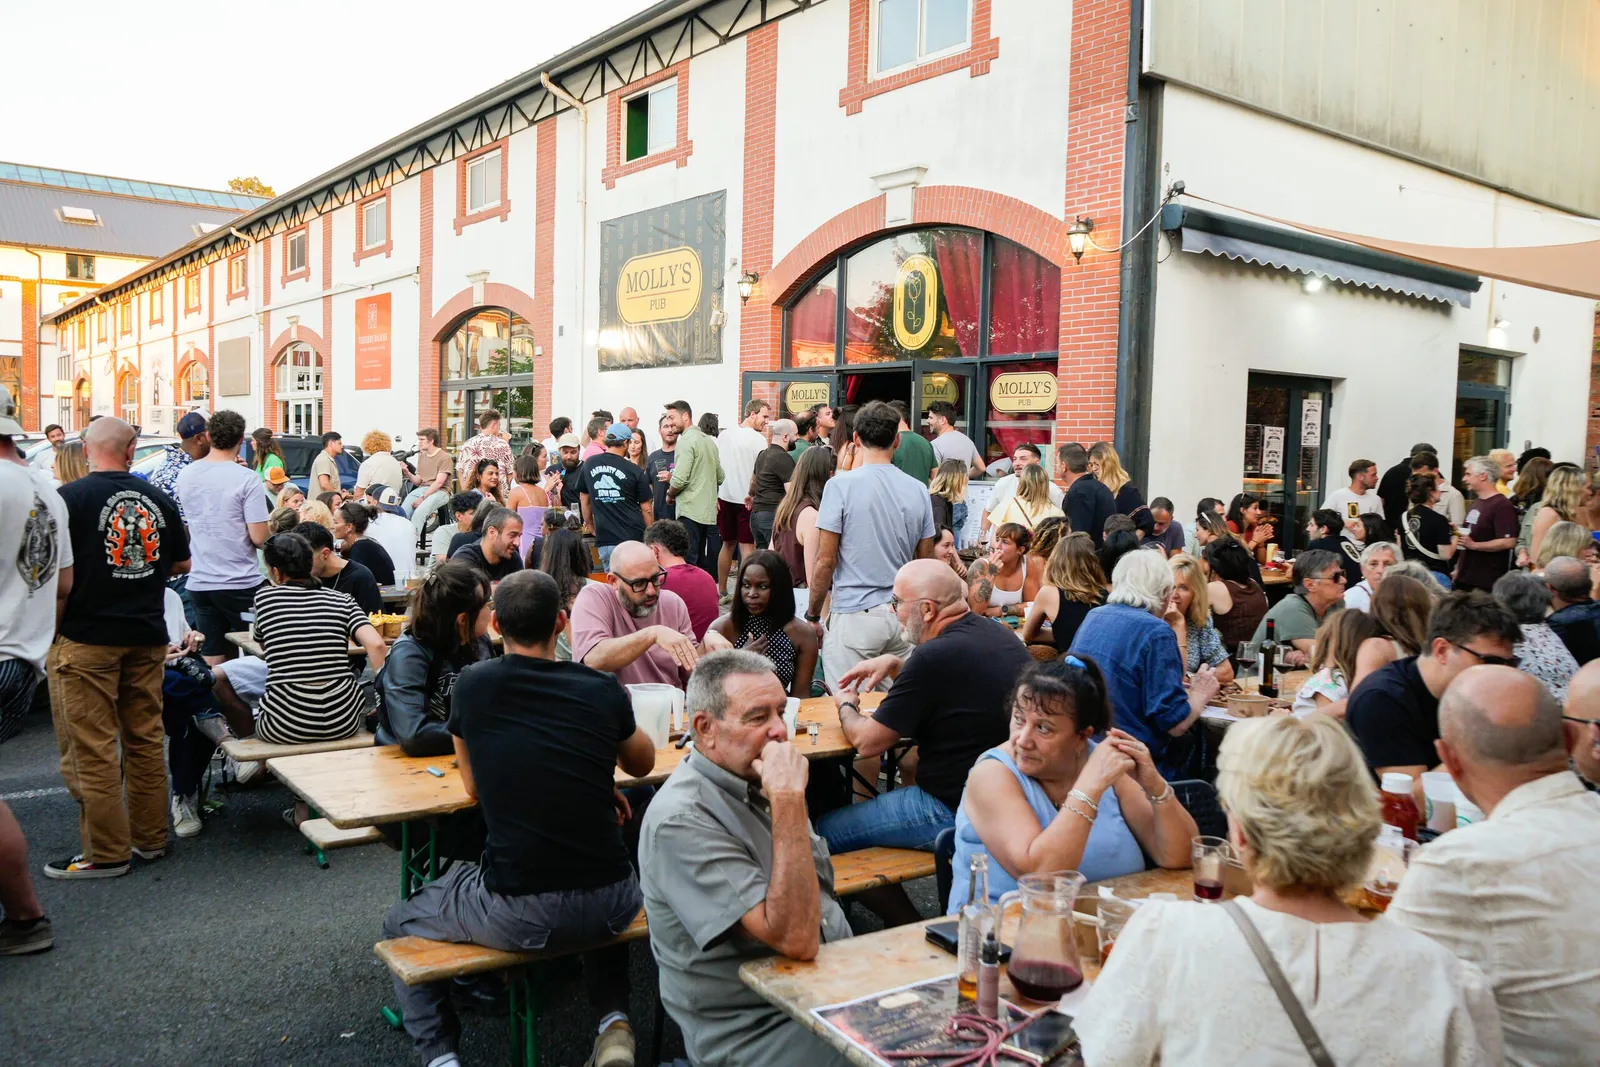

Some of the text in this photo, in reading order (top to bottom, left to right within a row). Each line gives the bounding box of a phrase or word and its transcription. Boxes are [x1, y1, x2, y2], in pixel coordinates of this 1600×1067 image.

[626, 262, 692, 294] MOLLY'S
[650, 297, 667, 311] PUB
[791, 389, 828, 400] MOLLY'S
[998, 381, 1052, 395] MOLLY'S
[1018, 398, 1032, 406] PUB
